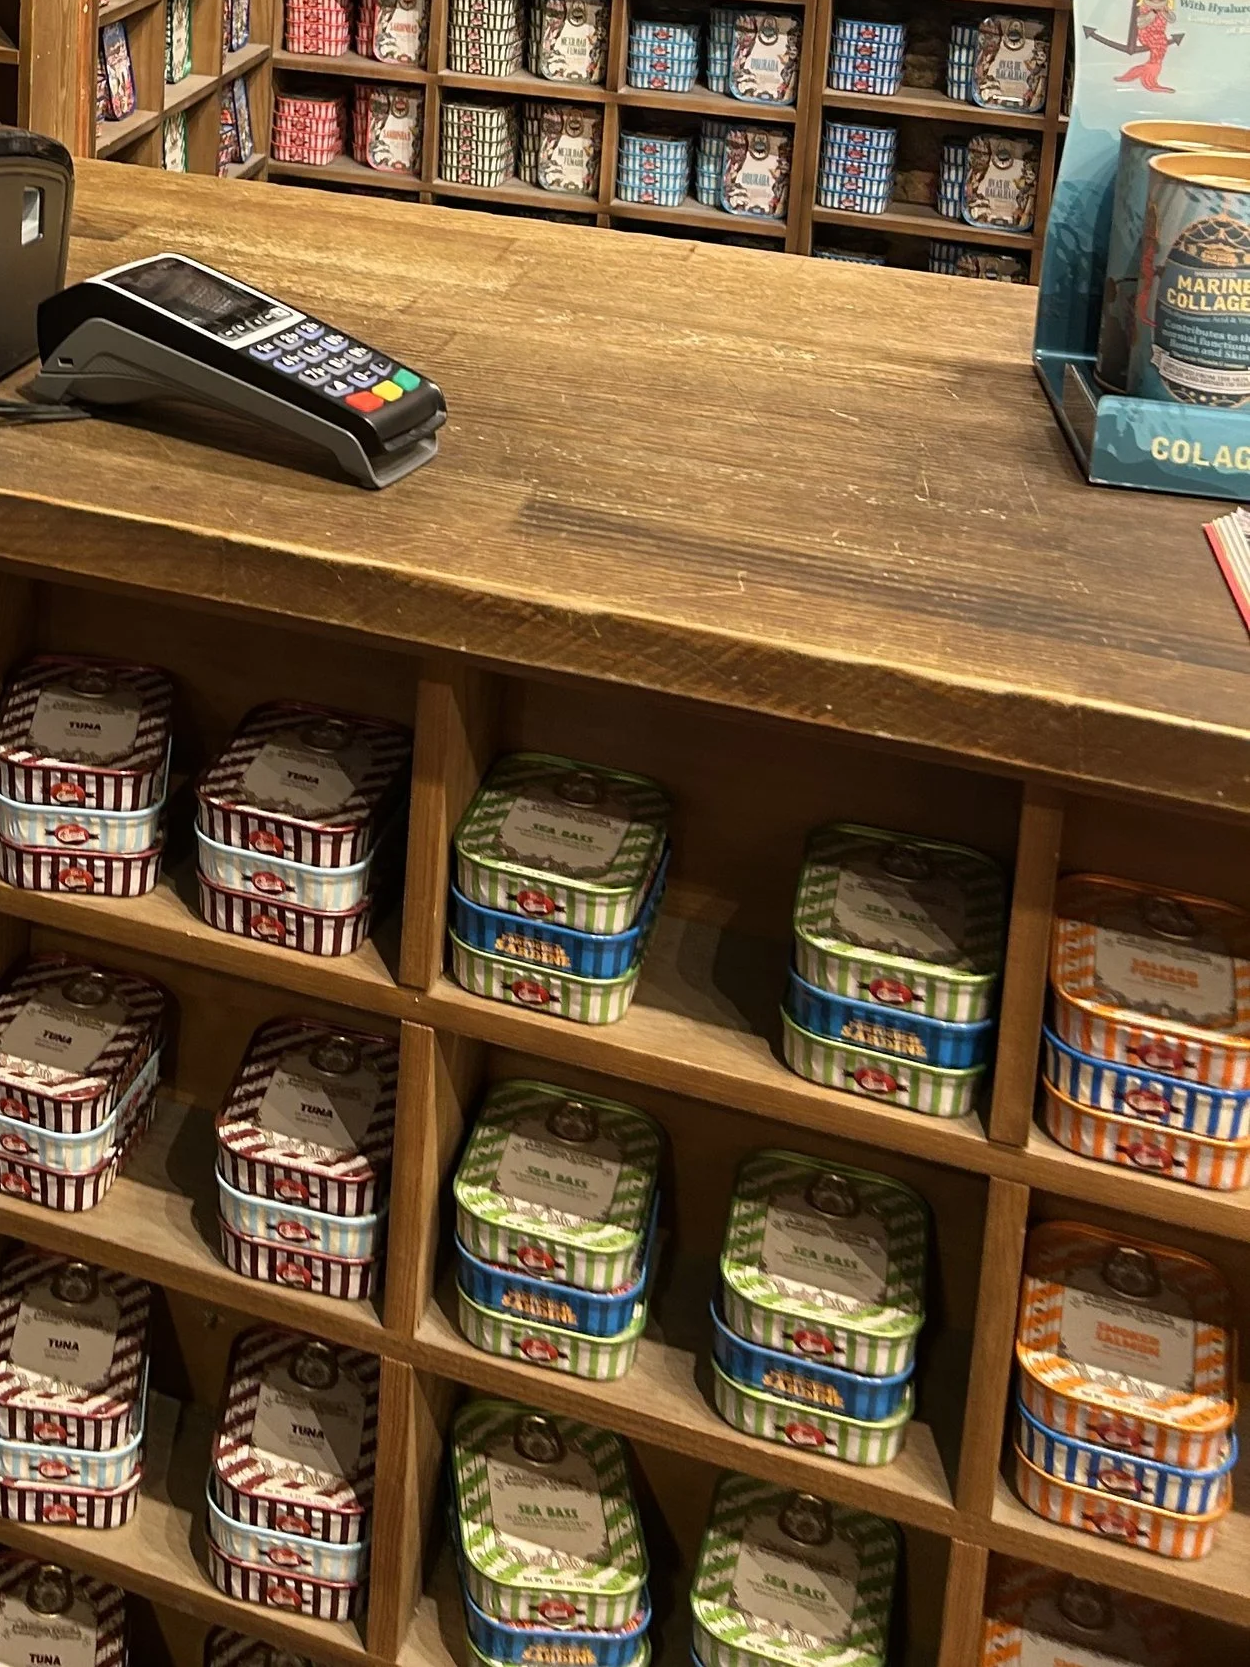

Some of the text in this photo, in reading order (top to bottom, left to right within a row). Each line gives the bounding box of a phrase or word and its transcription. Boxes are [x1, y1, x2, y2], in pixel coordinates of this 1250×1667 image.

[1164, 319, 1225, 339] Contributes
[1200, 337, 1246, 351] function
[1201, 348, 1222, 358] and
[1225, 349, 1250, 361] Skin
[69, 721, 101, 731] TUNA
[287, 771, 319, 785] TUNA
[533, 823, 594, 843] SEA BASS
[42, 1030, 73, 1045] TUNA
[301, 1103, 333, 1118] TUNA
[528, 1165, 588, 1188] SEA BASS
[793, 1245, 857, 1269] SEA BASS
[47, 1338, 79, 1351] TUNA
[291, 1424, 324, 1439] TUNA
[518, 1503, 577, 1518] SEA BASS
[762, 1574, 827, 1601] SEA BASS
[29, 1654, 61, 1665] TUNA
